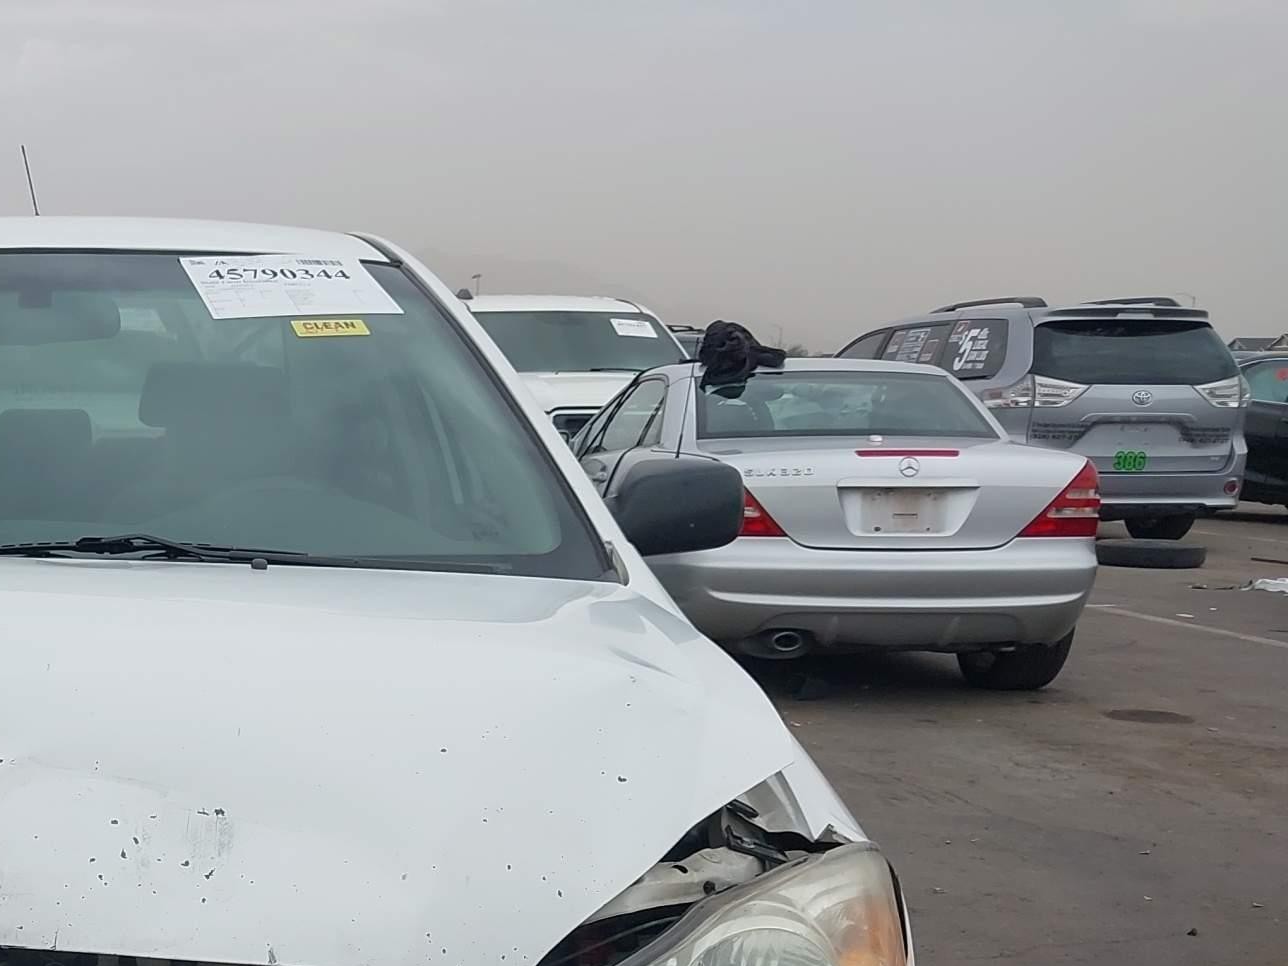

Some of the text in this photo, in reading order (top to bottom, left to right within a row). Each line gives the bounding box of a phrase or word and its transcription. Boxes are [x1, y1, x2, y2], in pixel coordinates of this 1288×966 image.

[208, 268, 351, 281] 45790344
[302, 322, 356, 330] CLEAN
[1113, 451, 1146, 471] 386
